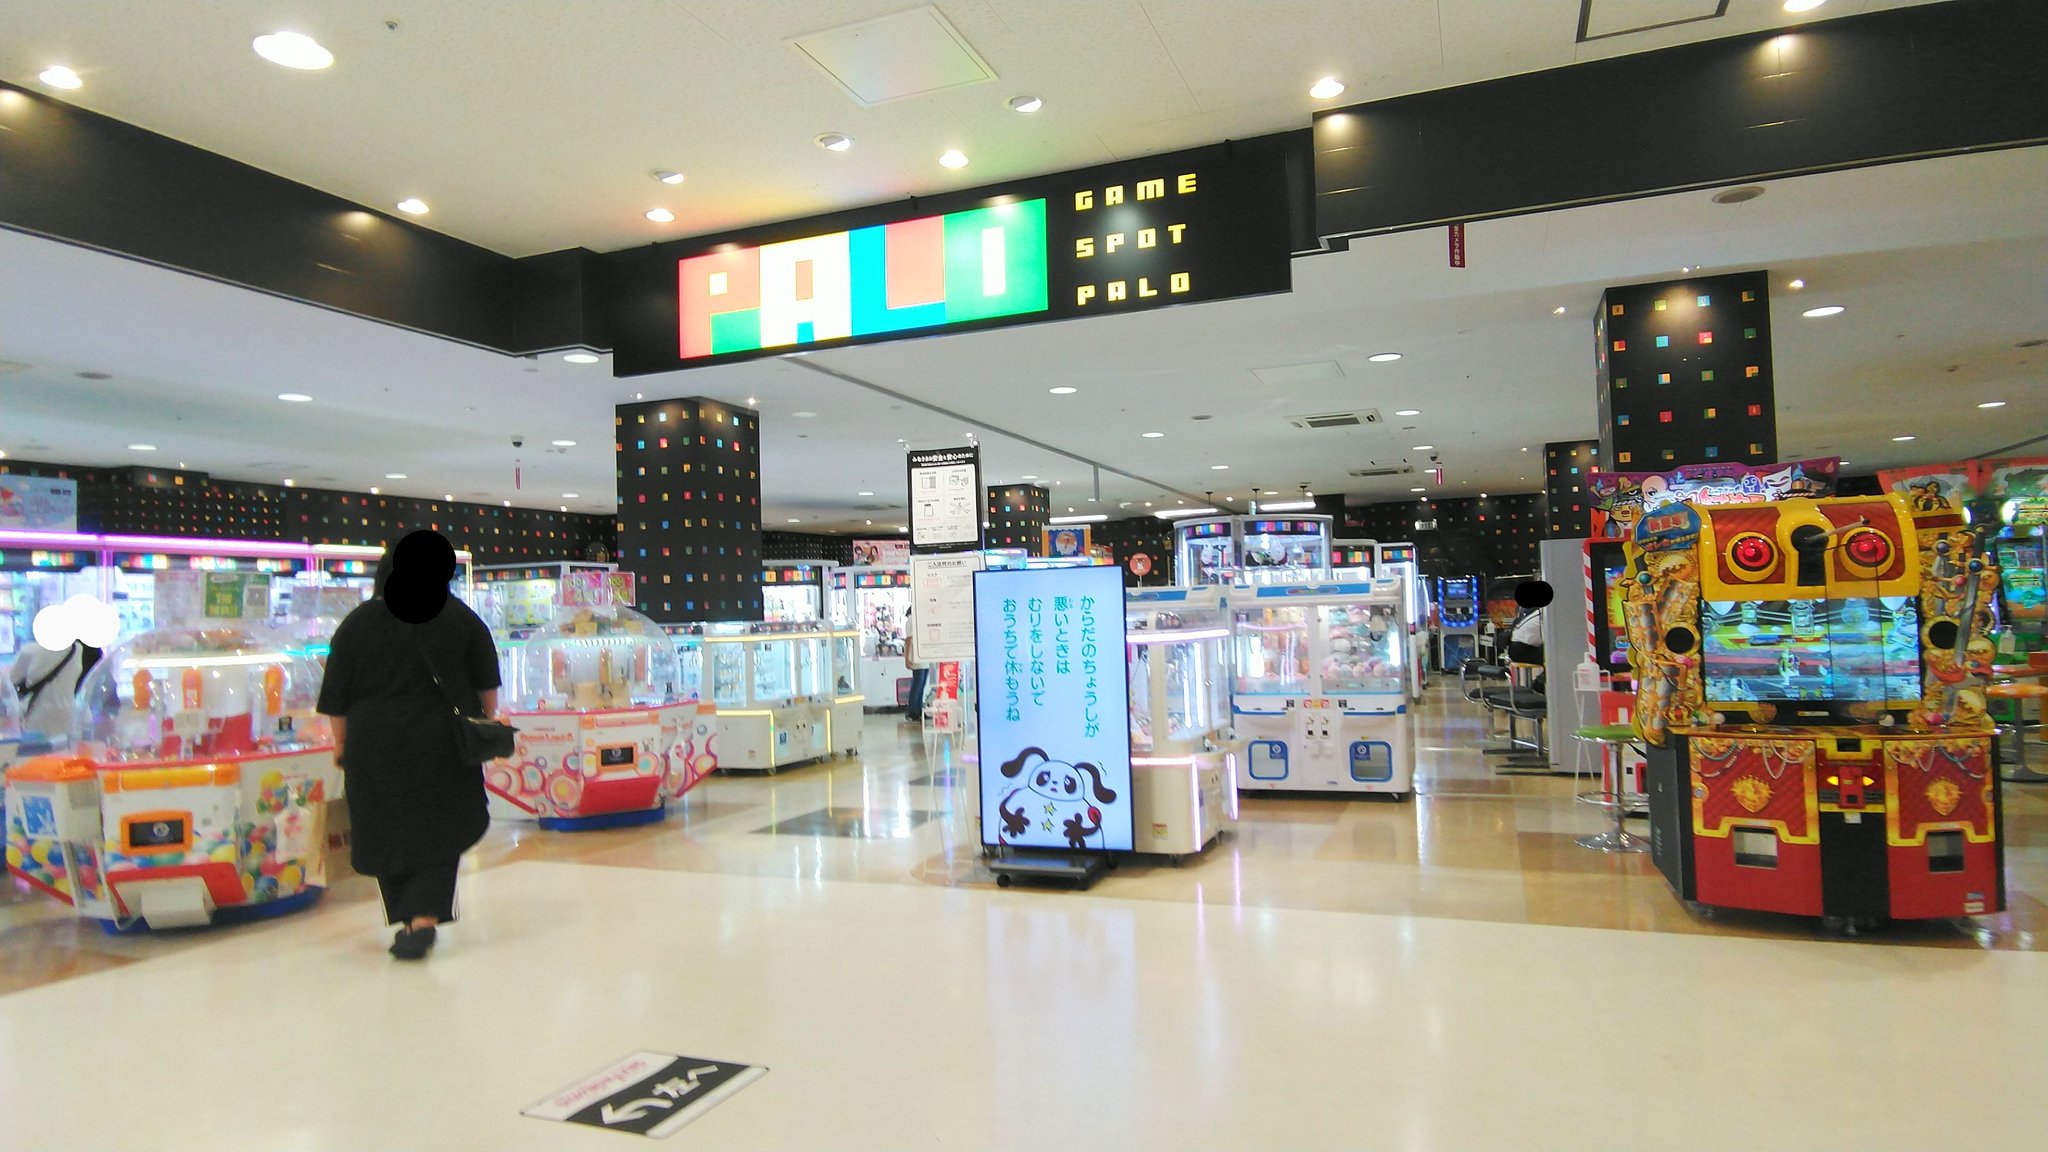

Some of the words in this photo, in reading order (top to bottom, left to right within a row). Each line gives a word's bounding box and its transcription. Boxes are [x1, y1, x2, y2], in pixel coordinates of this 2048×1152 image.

[1075, 173, 1197, 211] GAME
[1076, 223, 1186, 258] SPOT
[679, 198, 1048, 359] PALO
[1077, 272, 1190, 306] PALO
[1054, 596, 1071, 675] 悪いときは
[1080, 595, 1100, 738] からだのちょうしが
